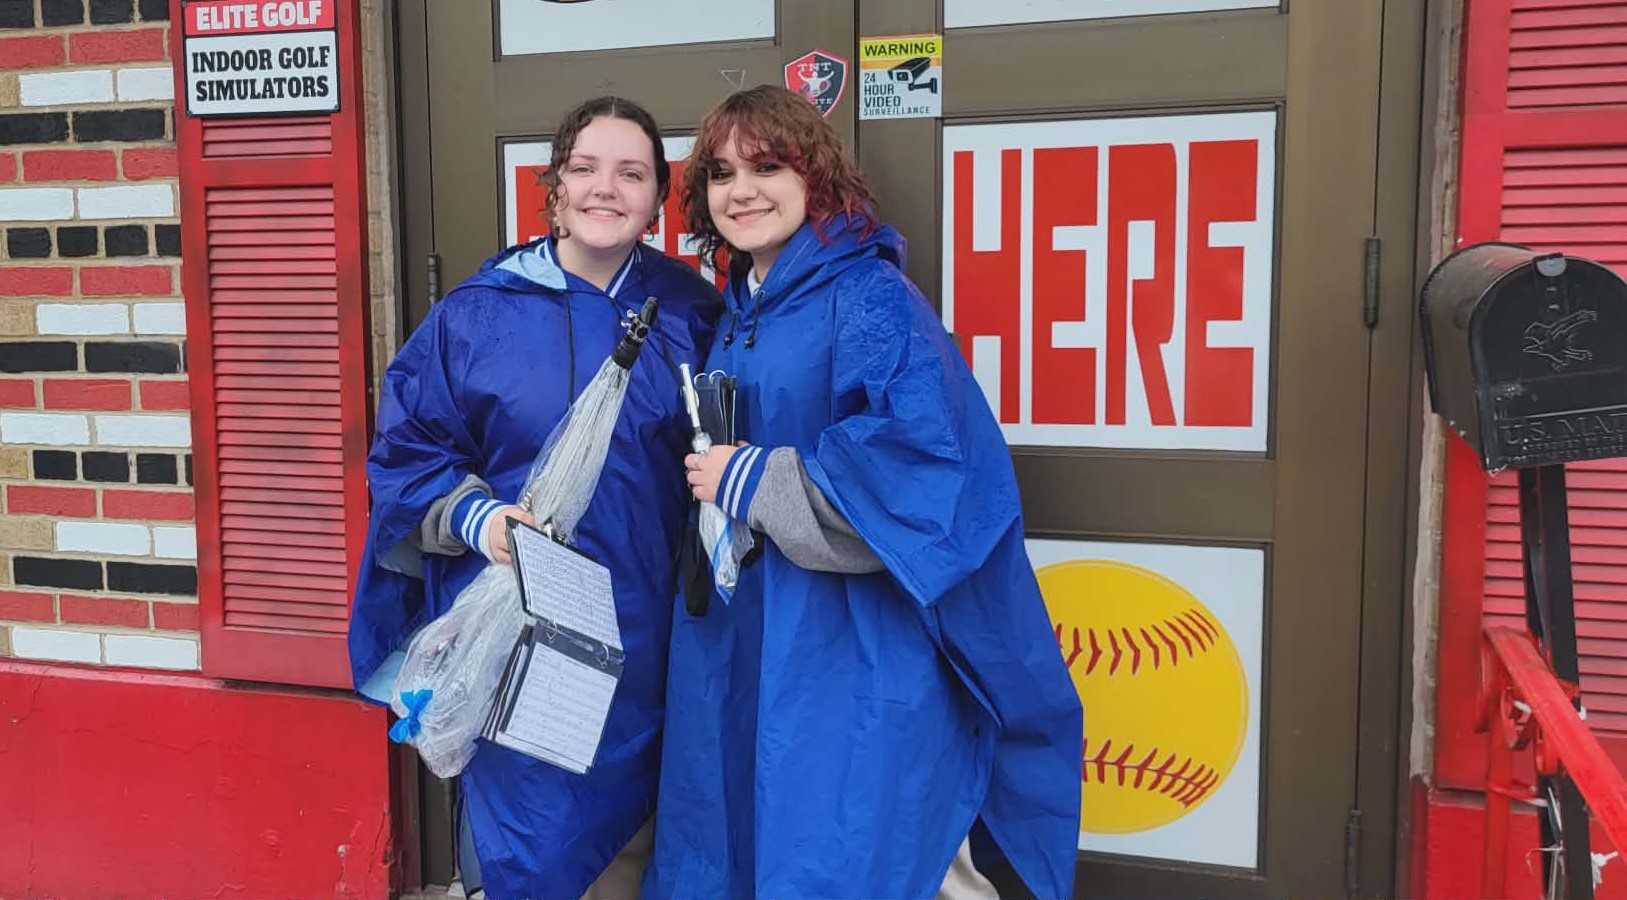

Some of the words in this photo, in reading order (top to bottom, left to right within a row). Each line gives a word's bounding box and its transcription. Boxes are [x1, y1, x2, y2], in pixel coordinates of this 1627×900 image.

[196, 5, 259, 31] ELITE
[262, 0, 322, 27] GOLF
[864, 42, 936, 56] WARNING
[192, 50, 273, 73] INDOOR
[278, 45, 330, 69] GOLF
[797, 62, 832, 72] TNT
[864, 72, 876, 84] 24
[196, 75, 329, 102] SIMULATORS
[864, 84, 895, 95] HOUR
[864, 96, 901, 108] VIDEO
[863, 106, 931, 116] SURVEILLANCE
[953, 139, 1259, 427] HERE
